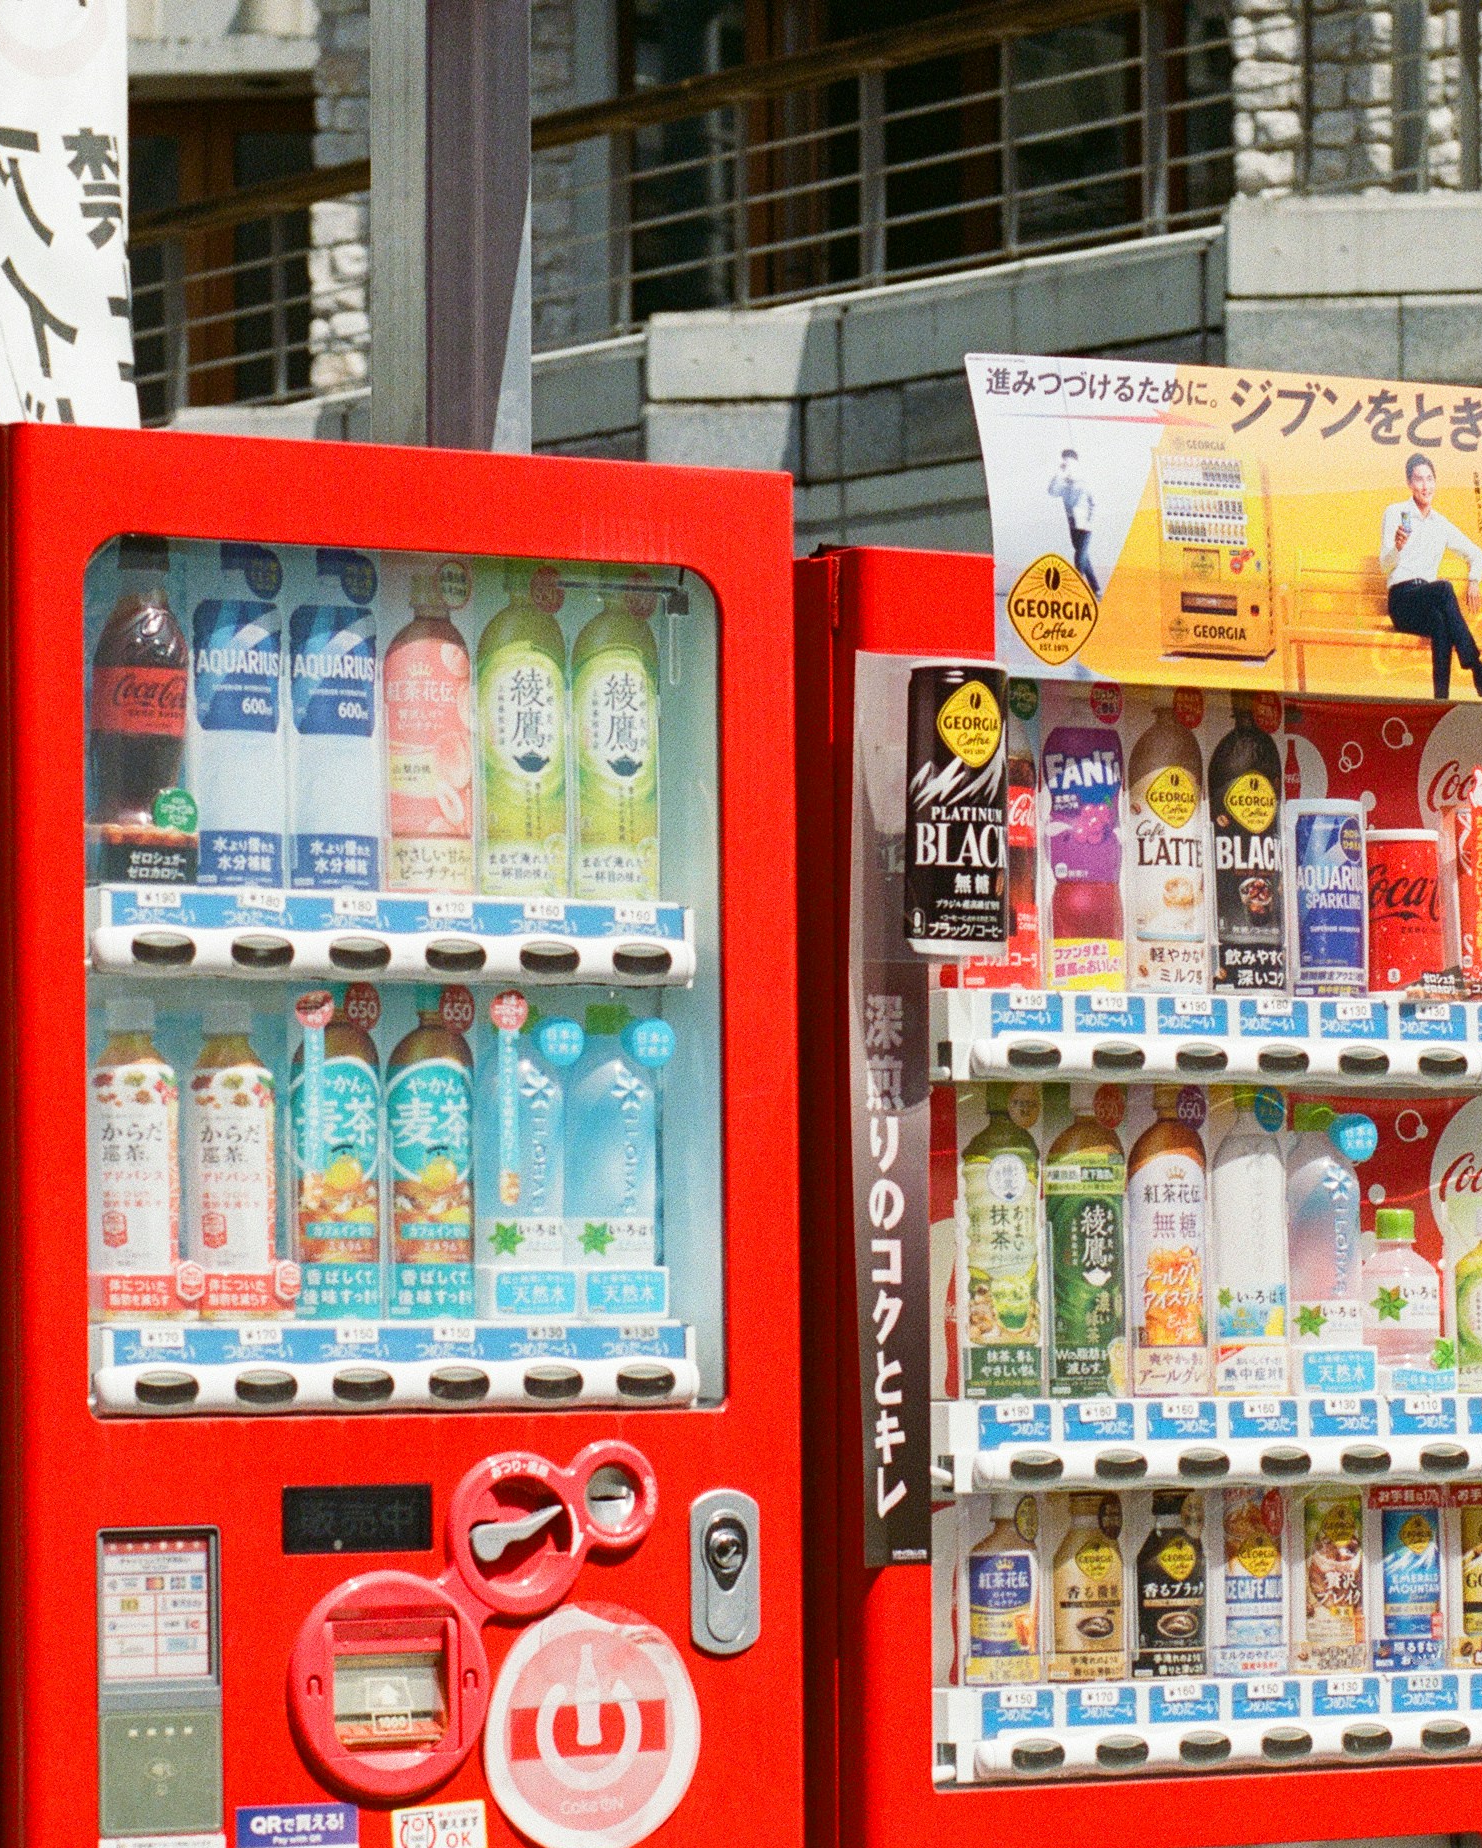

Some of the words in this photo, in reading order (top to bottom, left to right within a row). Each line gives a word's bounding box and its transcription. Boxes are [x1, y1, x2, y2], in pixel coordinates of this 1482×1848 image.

[984, 366, 1219, 410] 進みつづけるために。
[1013, 597, 1093, 622] GEORGIA
[1030, 621, 1078, 640] Coffee
[1192, 623, 1248, 642] GEORGIA
[196, 650, 280, 677] AQUARIUS
[293, 654, 375, 682] AQUARIUS
[510, 667, 546, 749] 綾鷹
[604, 672, 640, 752] 綾鷹
[942, 715, 1000, 733] GEORGIA
[956, 732, 990, 748] Coffee
[1149, 791, 1196, 804] GEORGIA
[1229, 795, 1275, 808] GEORGIA
[129, 851, 187, 867] ゼロシュガー
[1136, 837, 1204, 868] LATTE
[953, 872, 991, 896] 無糖
[1224, 948, 1284, 967] 飲みやすく
[347, 1001, 378, 1021] 650
[442, 1003, 473, 1022] 650
[101, 1122, 163, 1143] からだ
[392, 1097, 470, 1149] 麦茶
[200, 1124, 261, 1144] からだ
[1152, 1211, 1199, 1240] 無糖
[1080, 1205, 1108, 1269] 綾鷹
[867, 996, 908, 1519] 深煎りのコクとキレ
[1317, 1364, 1368, 1384] 天然水
[249, 1813, 345, 1835] QRで買える!
[445, 1831, 472, 1848] OK
